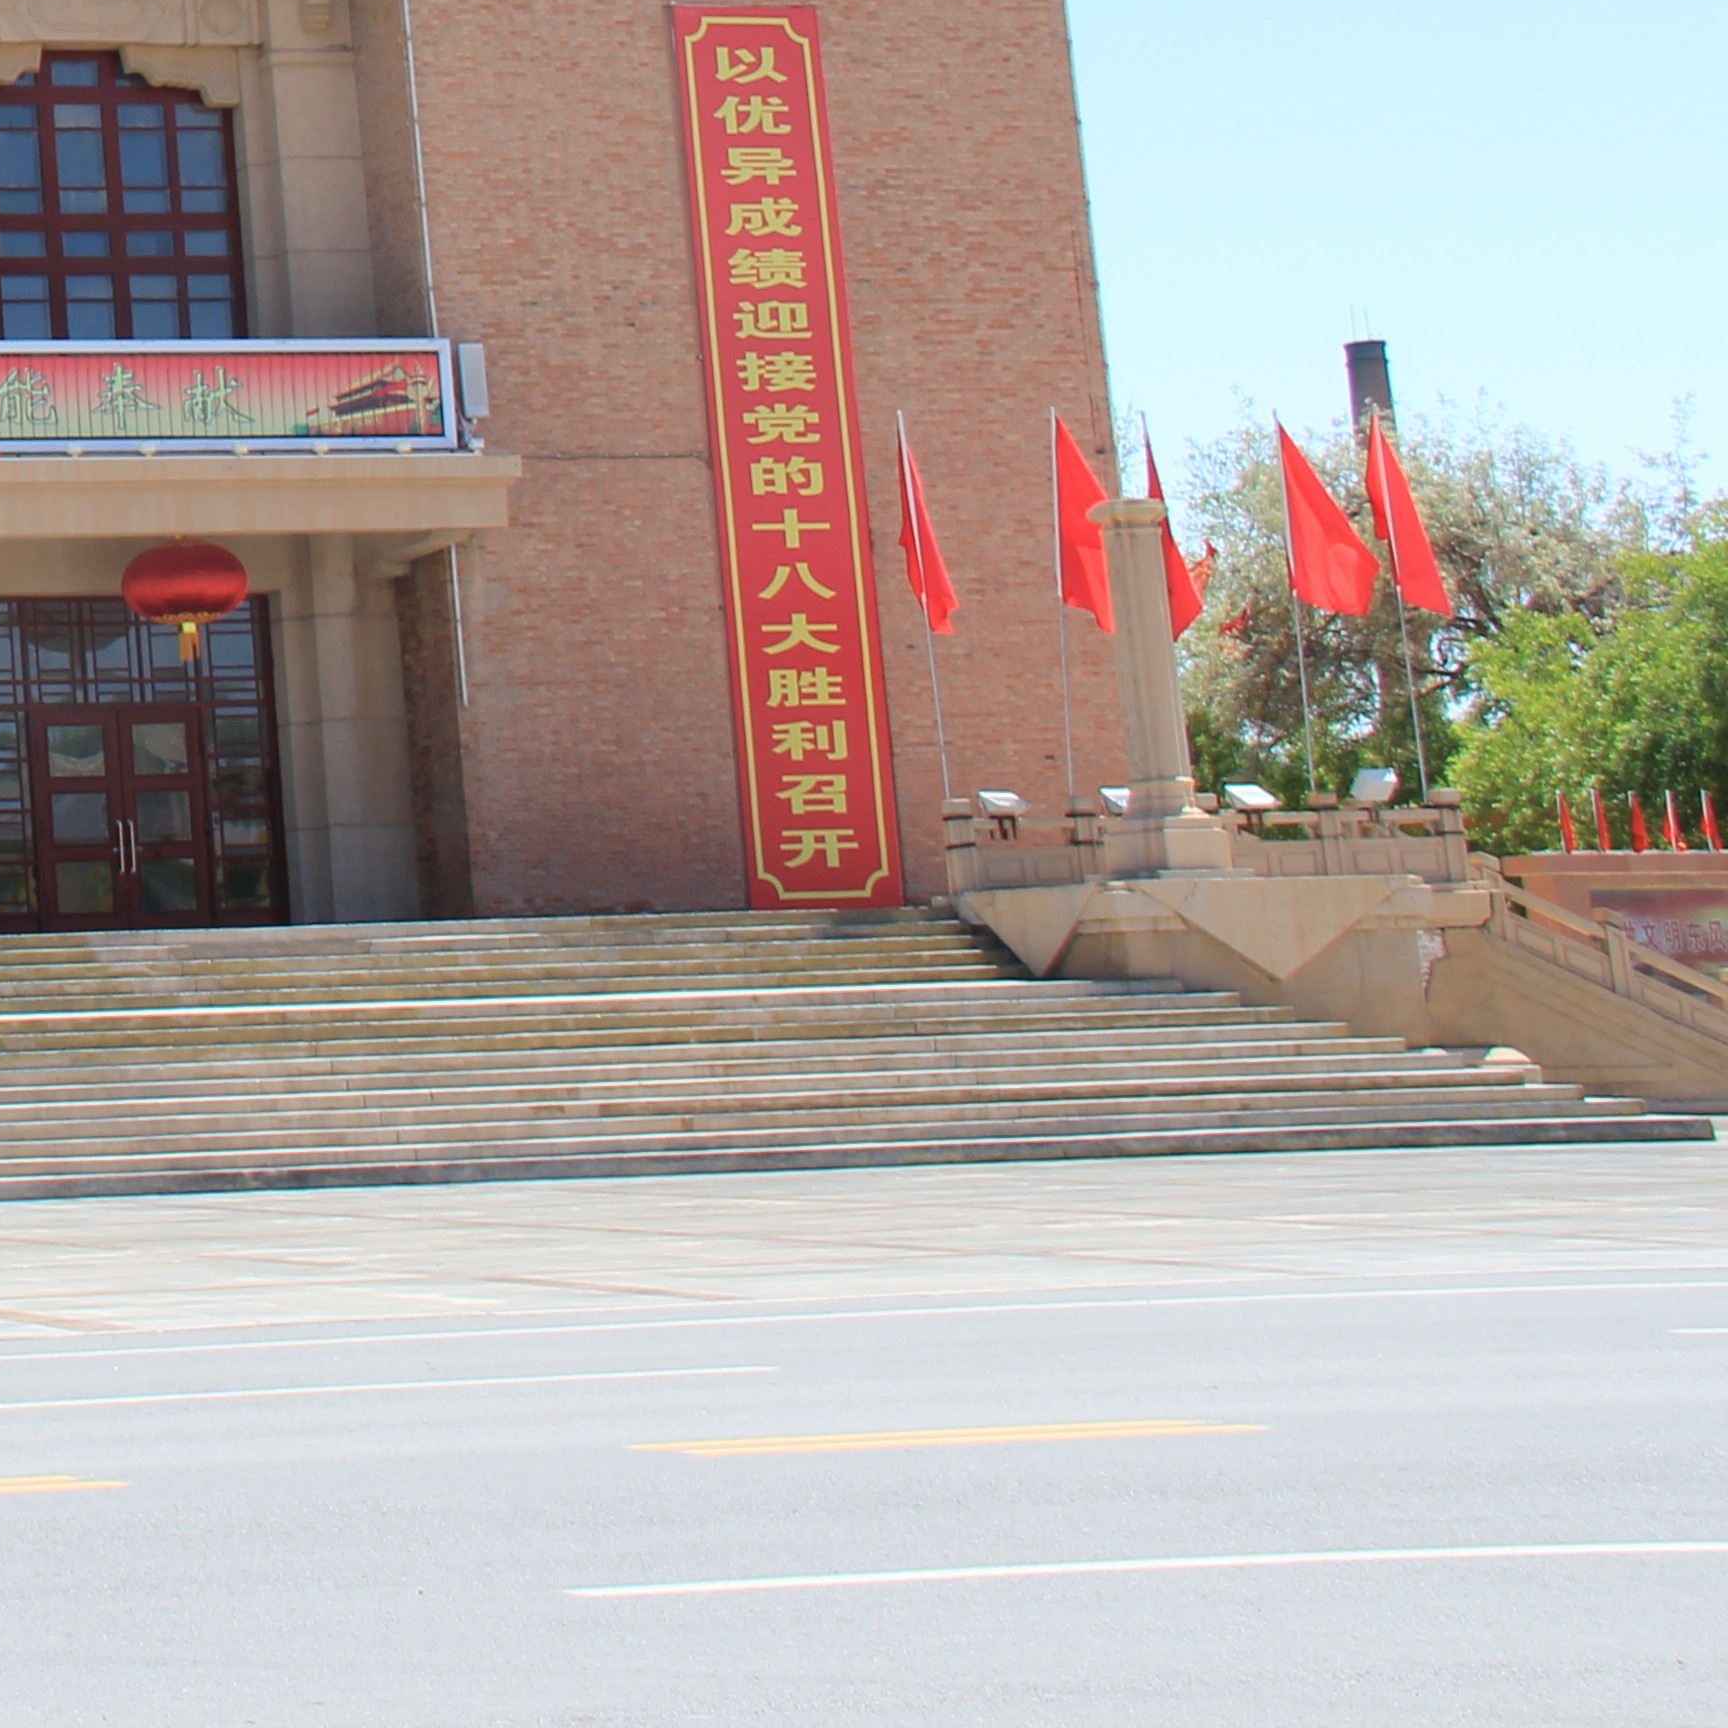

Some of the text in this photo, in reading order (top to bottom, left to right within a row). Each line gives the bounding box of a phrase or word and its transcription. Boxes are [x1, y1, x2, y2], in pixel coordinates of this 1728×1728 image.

[713, 44, 859, 869] 以优异成绩迎接党的十八大胜利召开
